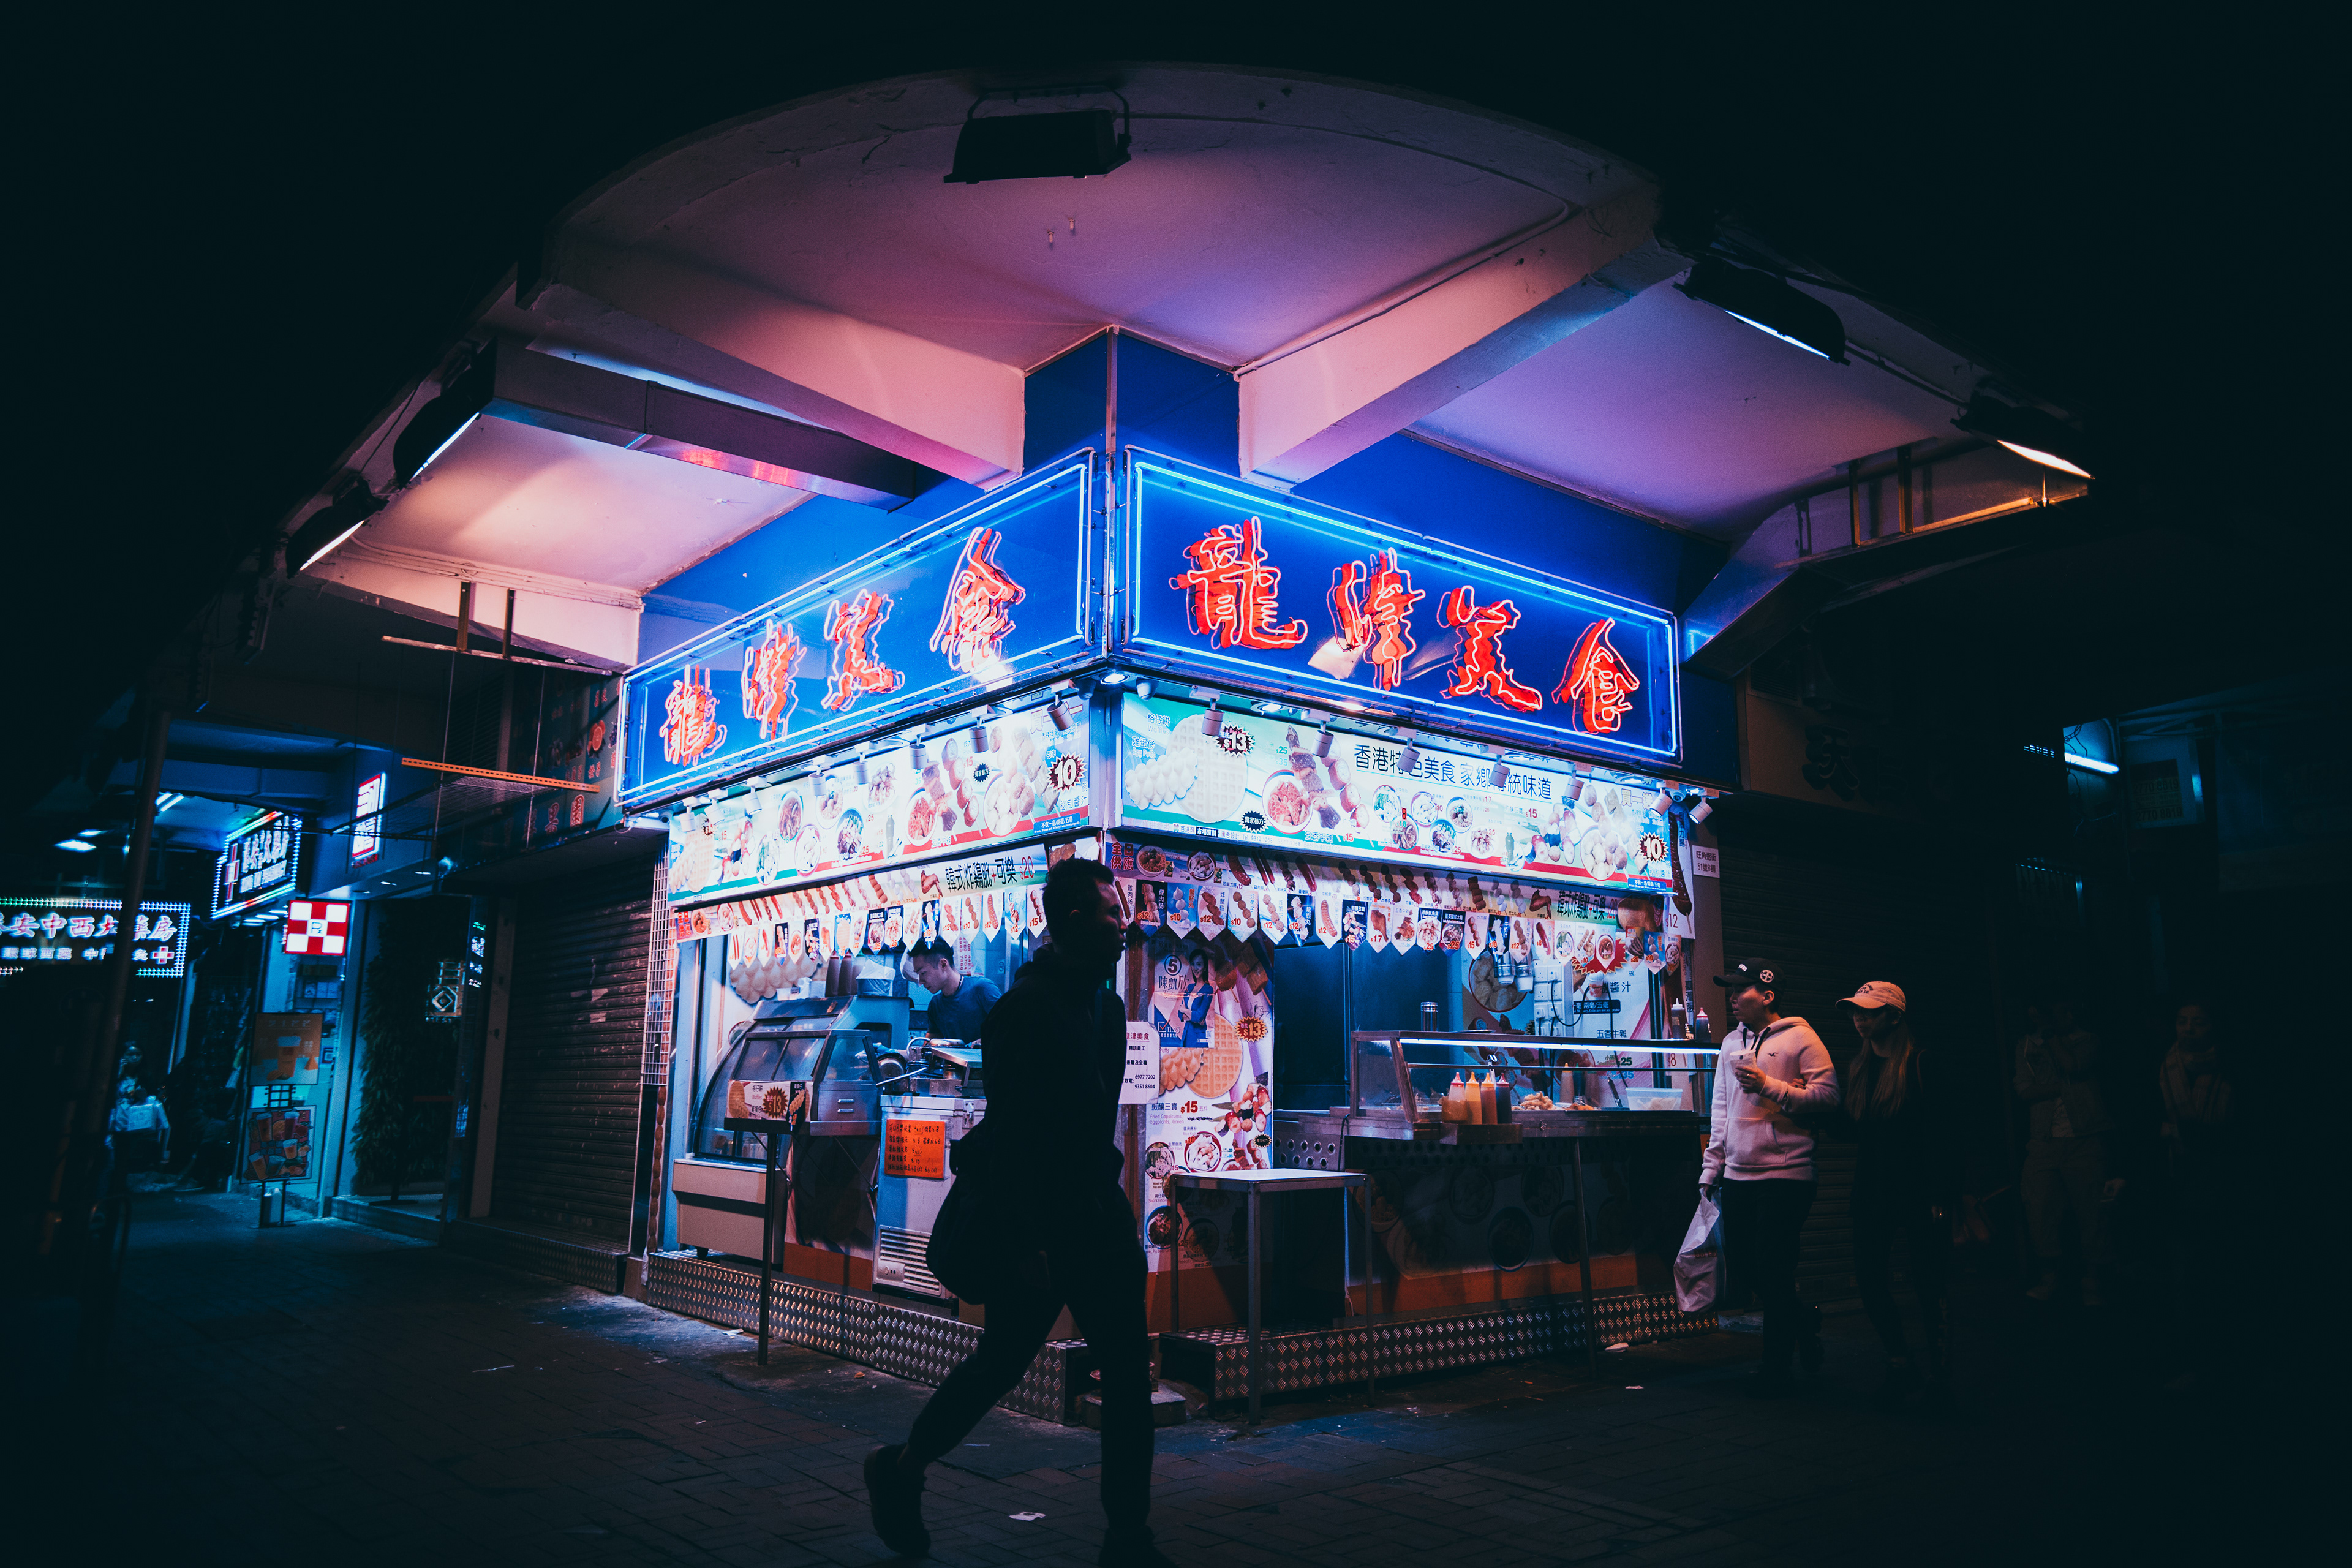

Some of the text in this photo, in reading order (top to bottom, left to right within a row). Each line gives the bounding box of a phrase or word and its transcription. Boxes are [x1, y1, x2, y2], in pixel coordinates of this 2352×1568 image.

[1224, 732, 1246, 751] $13
[1276, 746, 1287, 755] $25
[1054, 759, 1076, 788] 10
[1525, 808, 1538, 818] $15
[1643, 837, 1662, 859] 10
[1029, 917, 1038, 927] $15
[1137, 911, 1150, 920] $12
[1665, 914, 1678, 929] $12
[1345, 934, 1355, 943] $15
[1447, 940, 1460, 949] $25
[1167, 958, 1178, 973] 5
[1243, 1023, 1261, 1036] $13
[1180, 1101, 1198, 1114] $15
